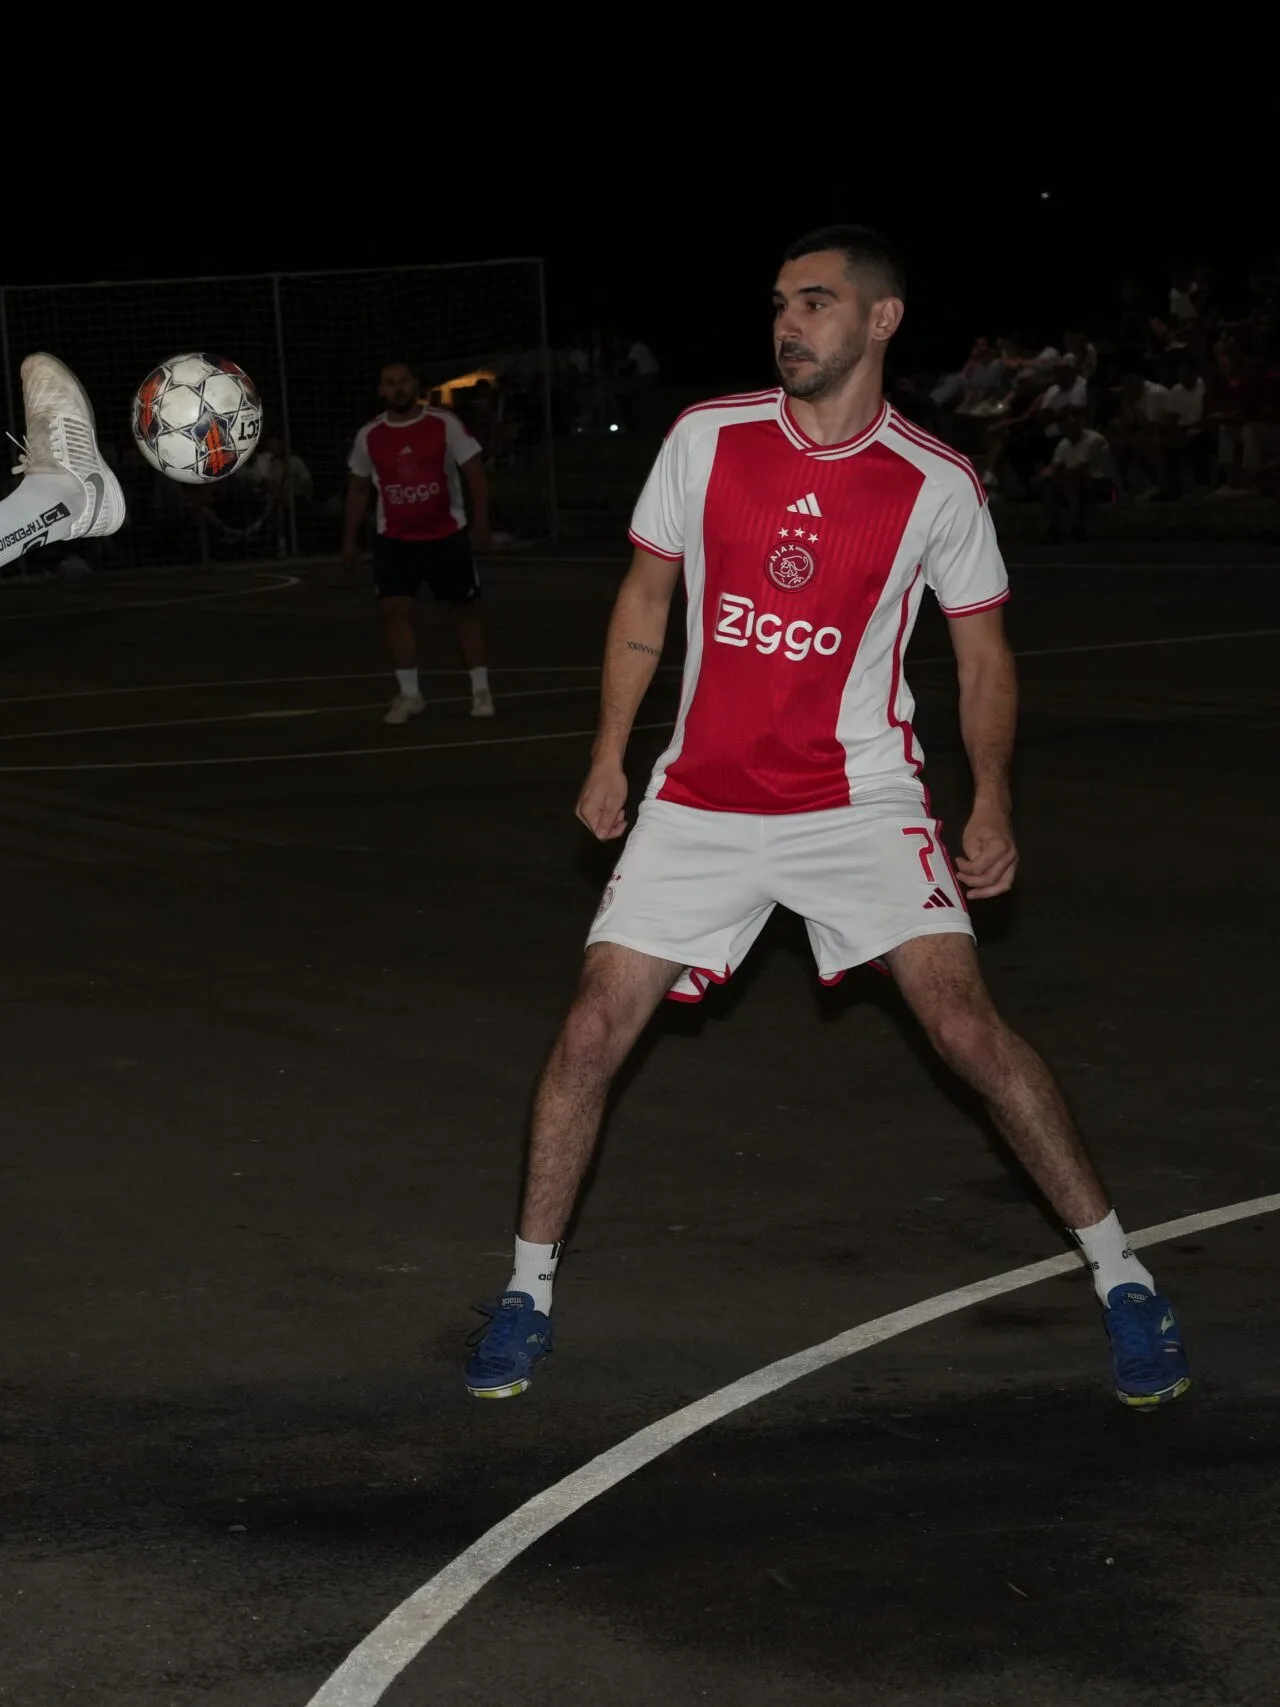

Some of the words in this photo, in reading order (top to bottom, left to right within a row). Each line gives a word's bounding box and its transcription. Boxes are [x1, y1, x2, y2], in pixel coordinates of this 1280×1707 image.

[385, 482, 440, 504] Ziggo
[770, 544, 795, 562] AJAX
[714, 592, 842, 662] Ziggo
[902, 827, 935, 882] 7
